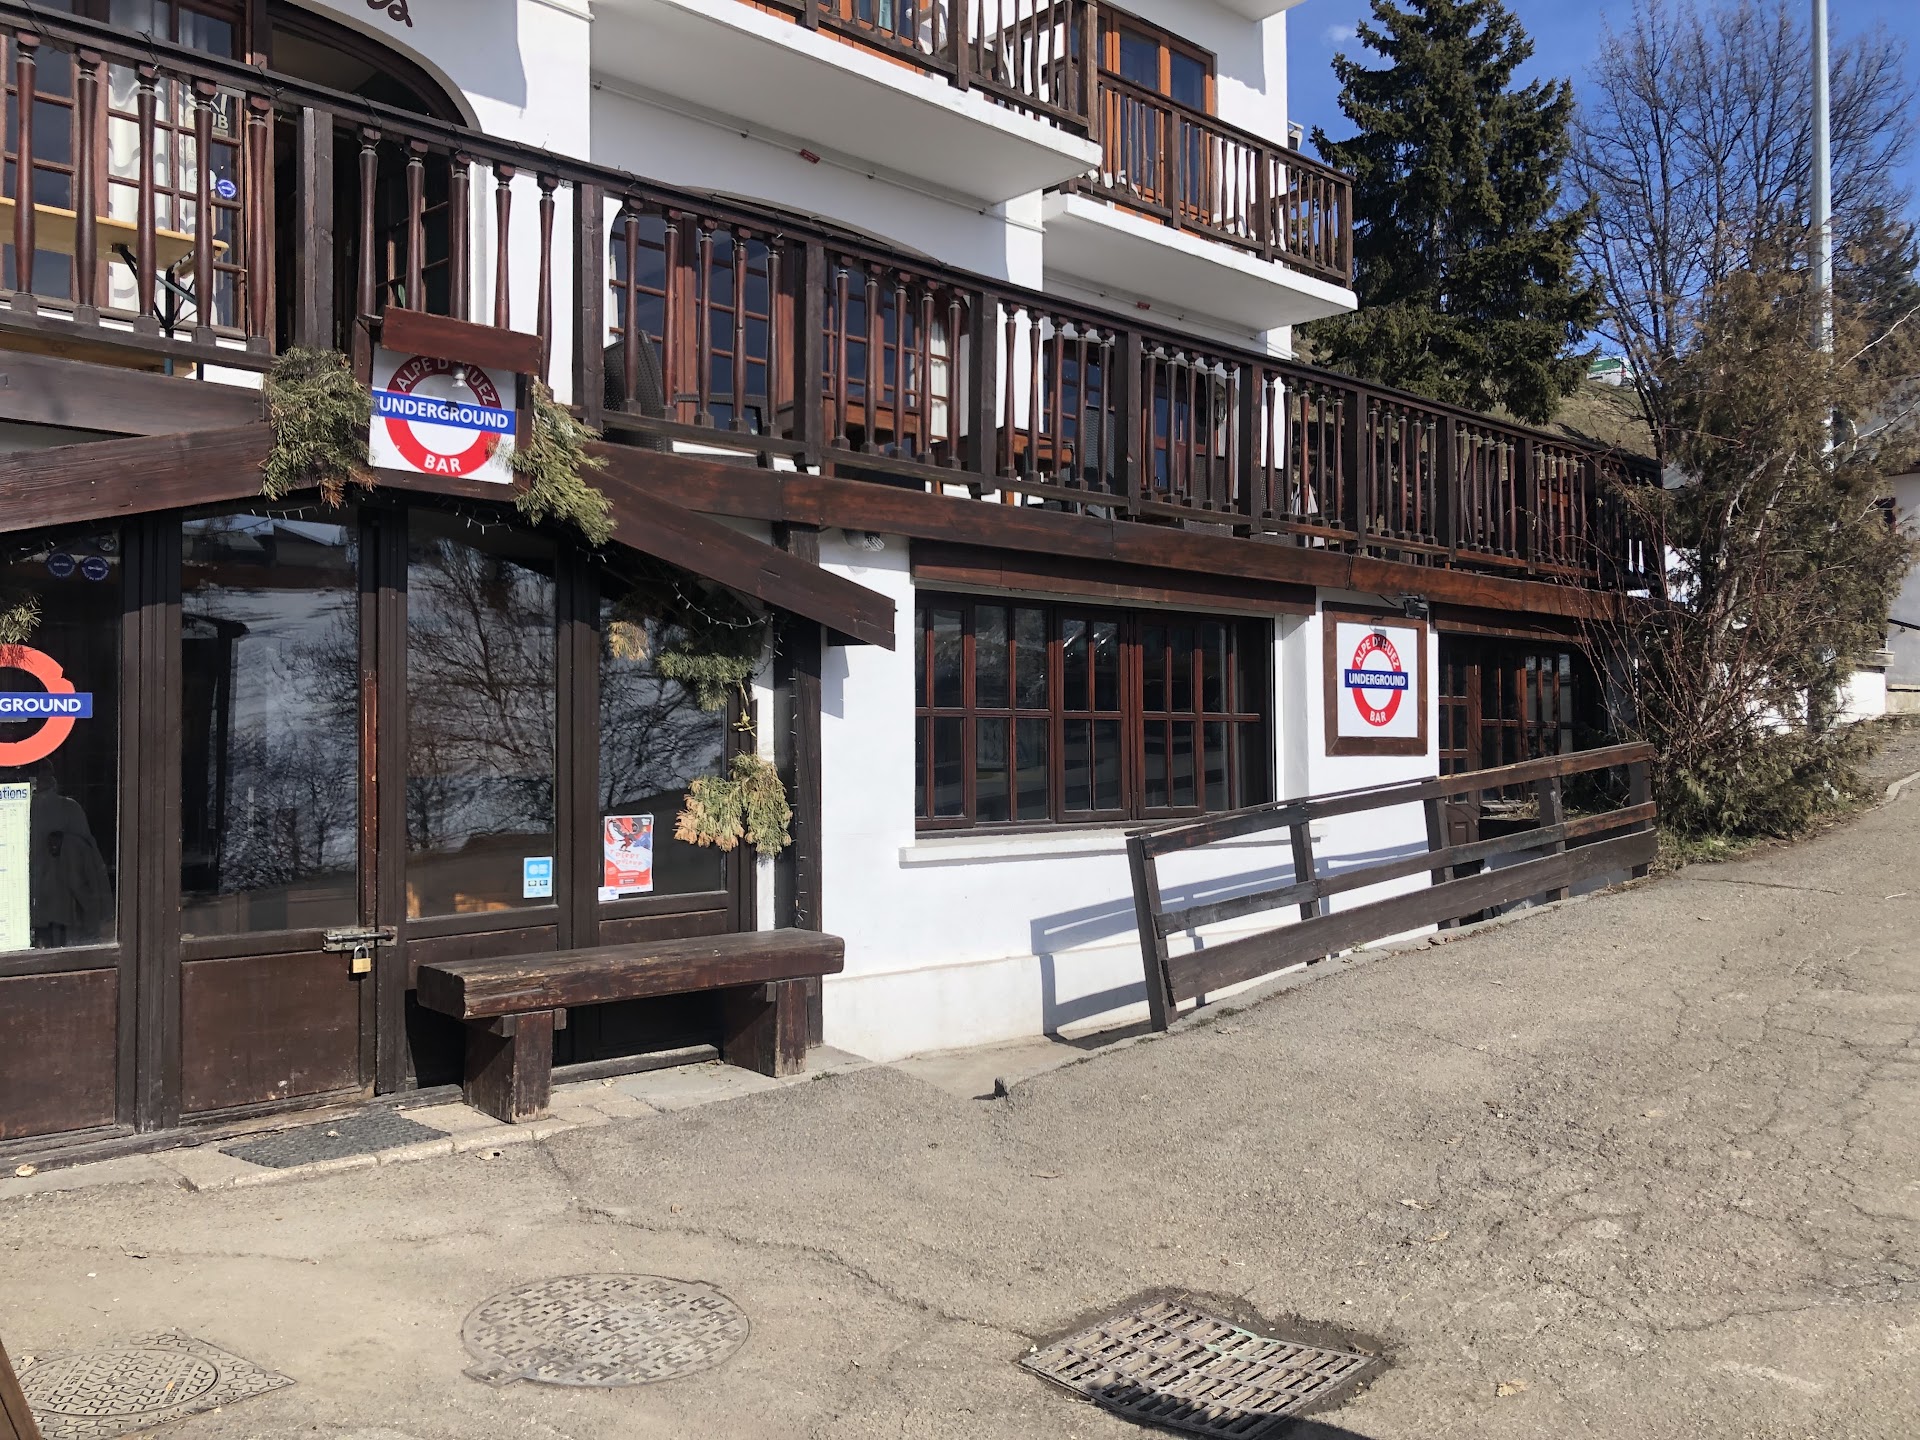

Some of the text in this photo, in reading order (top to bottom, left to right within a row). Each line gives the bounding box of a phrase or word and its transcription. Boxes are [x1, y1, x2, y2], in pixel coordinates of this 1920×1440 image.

[396, 357, 433, 392] ALPE
[379, 395, 509, 429] UNDERGROUND
[424, 454, 461, 473] BAR
[1355, 639, 1372, 667] ALPE
[1348, 673, 1406, 687] UNDERGROUND
[1369, 711, 1387, 723] BAR
